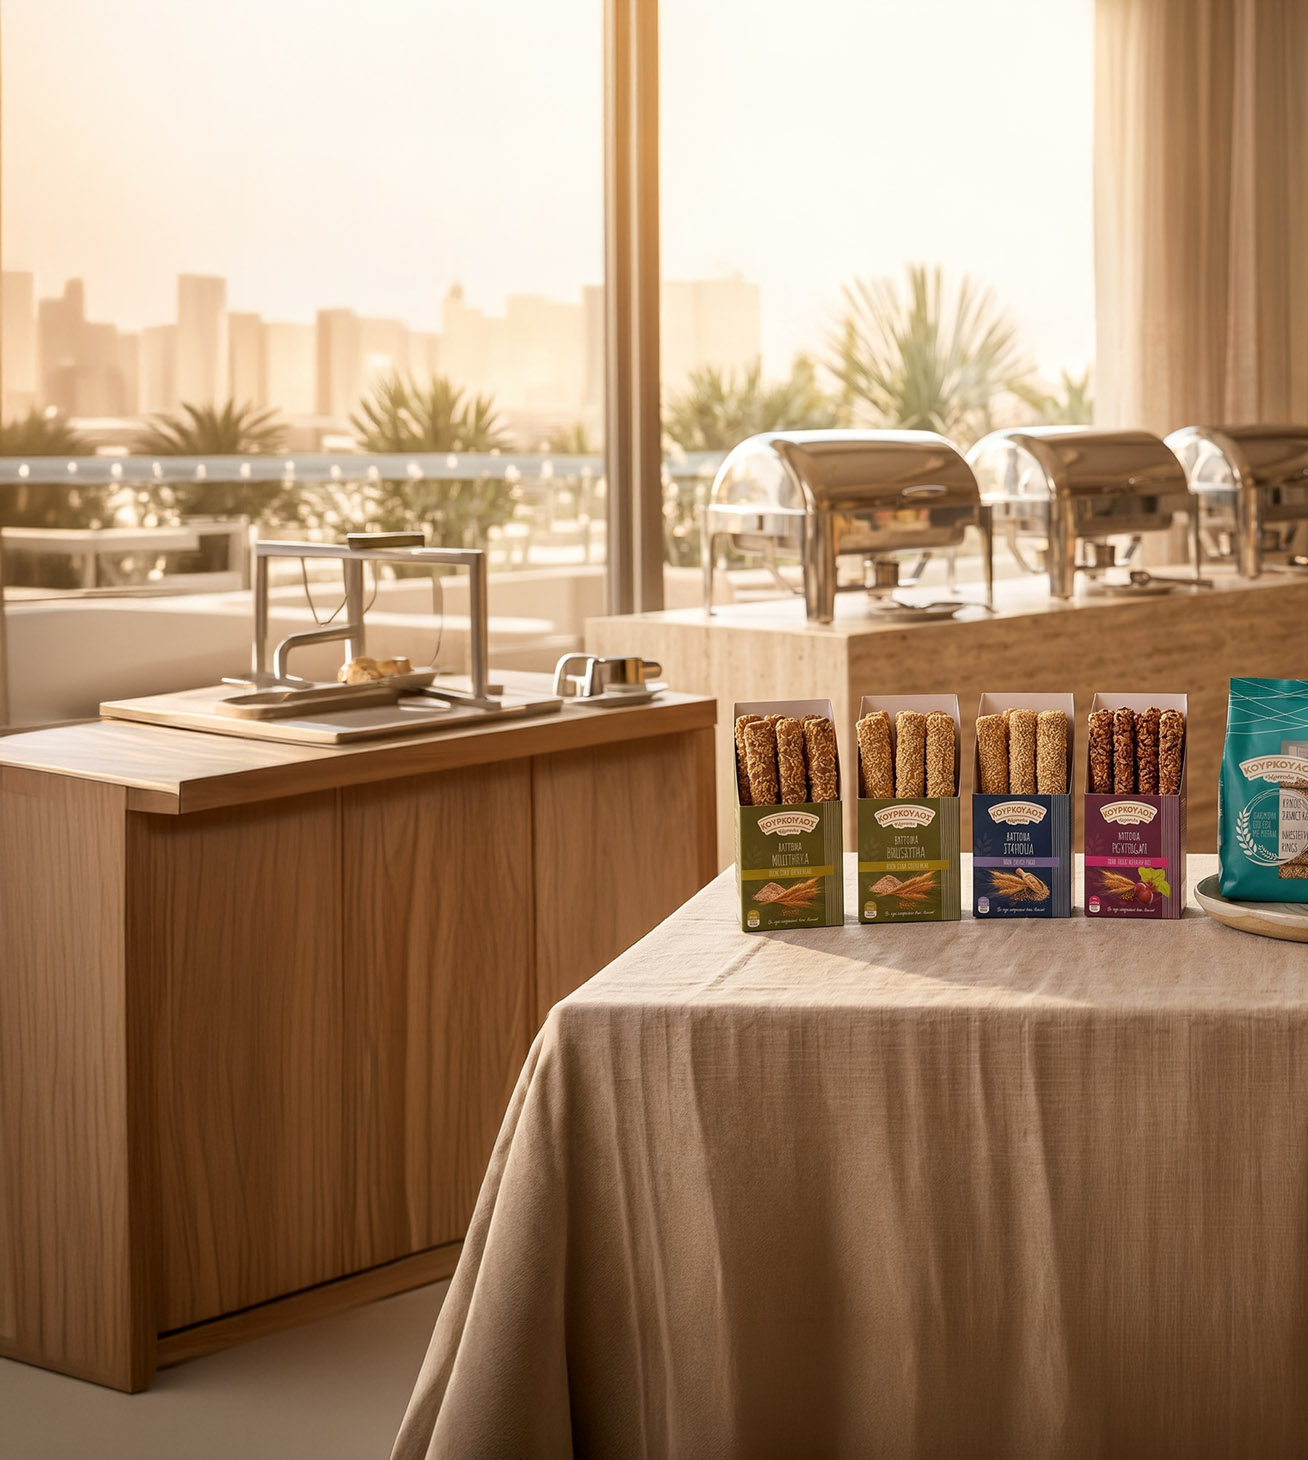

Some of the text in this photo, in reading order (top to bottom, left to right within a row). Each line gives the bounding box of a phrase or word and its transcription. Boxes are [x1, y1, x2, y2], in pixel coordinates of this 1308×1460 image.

[877, 809, 932, 823] ΚΟΥΡΚΟΥΛΟΣ
[991, 806, 1044, 819] ΚΟΥΡΚΟΥΛΟΣ
[1103, 806, 1154, 819] ΚΟΥΡΚΟΥΛΟΣ
[1281, 842, 1298, 853] RINGS
